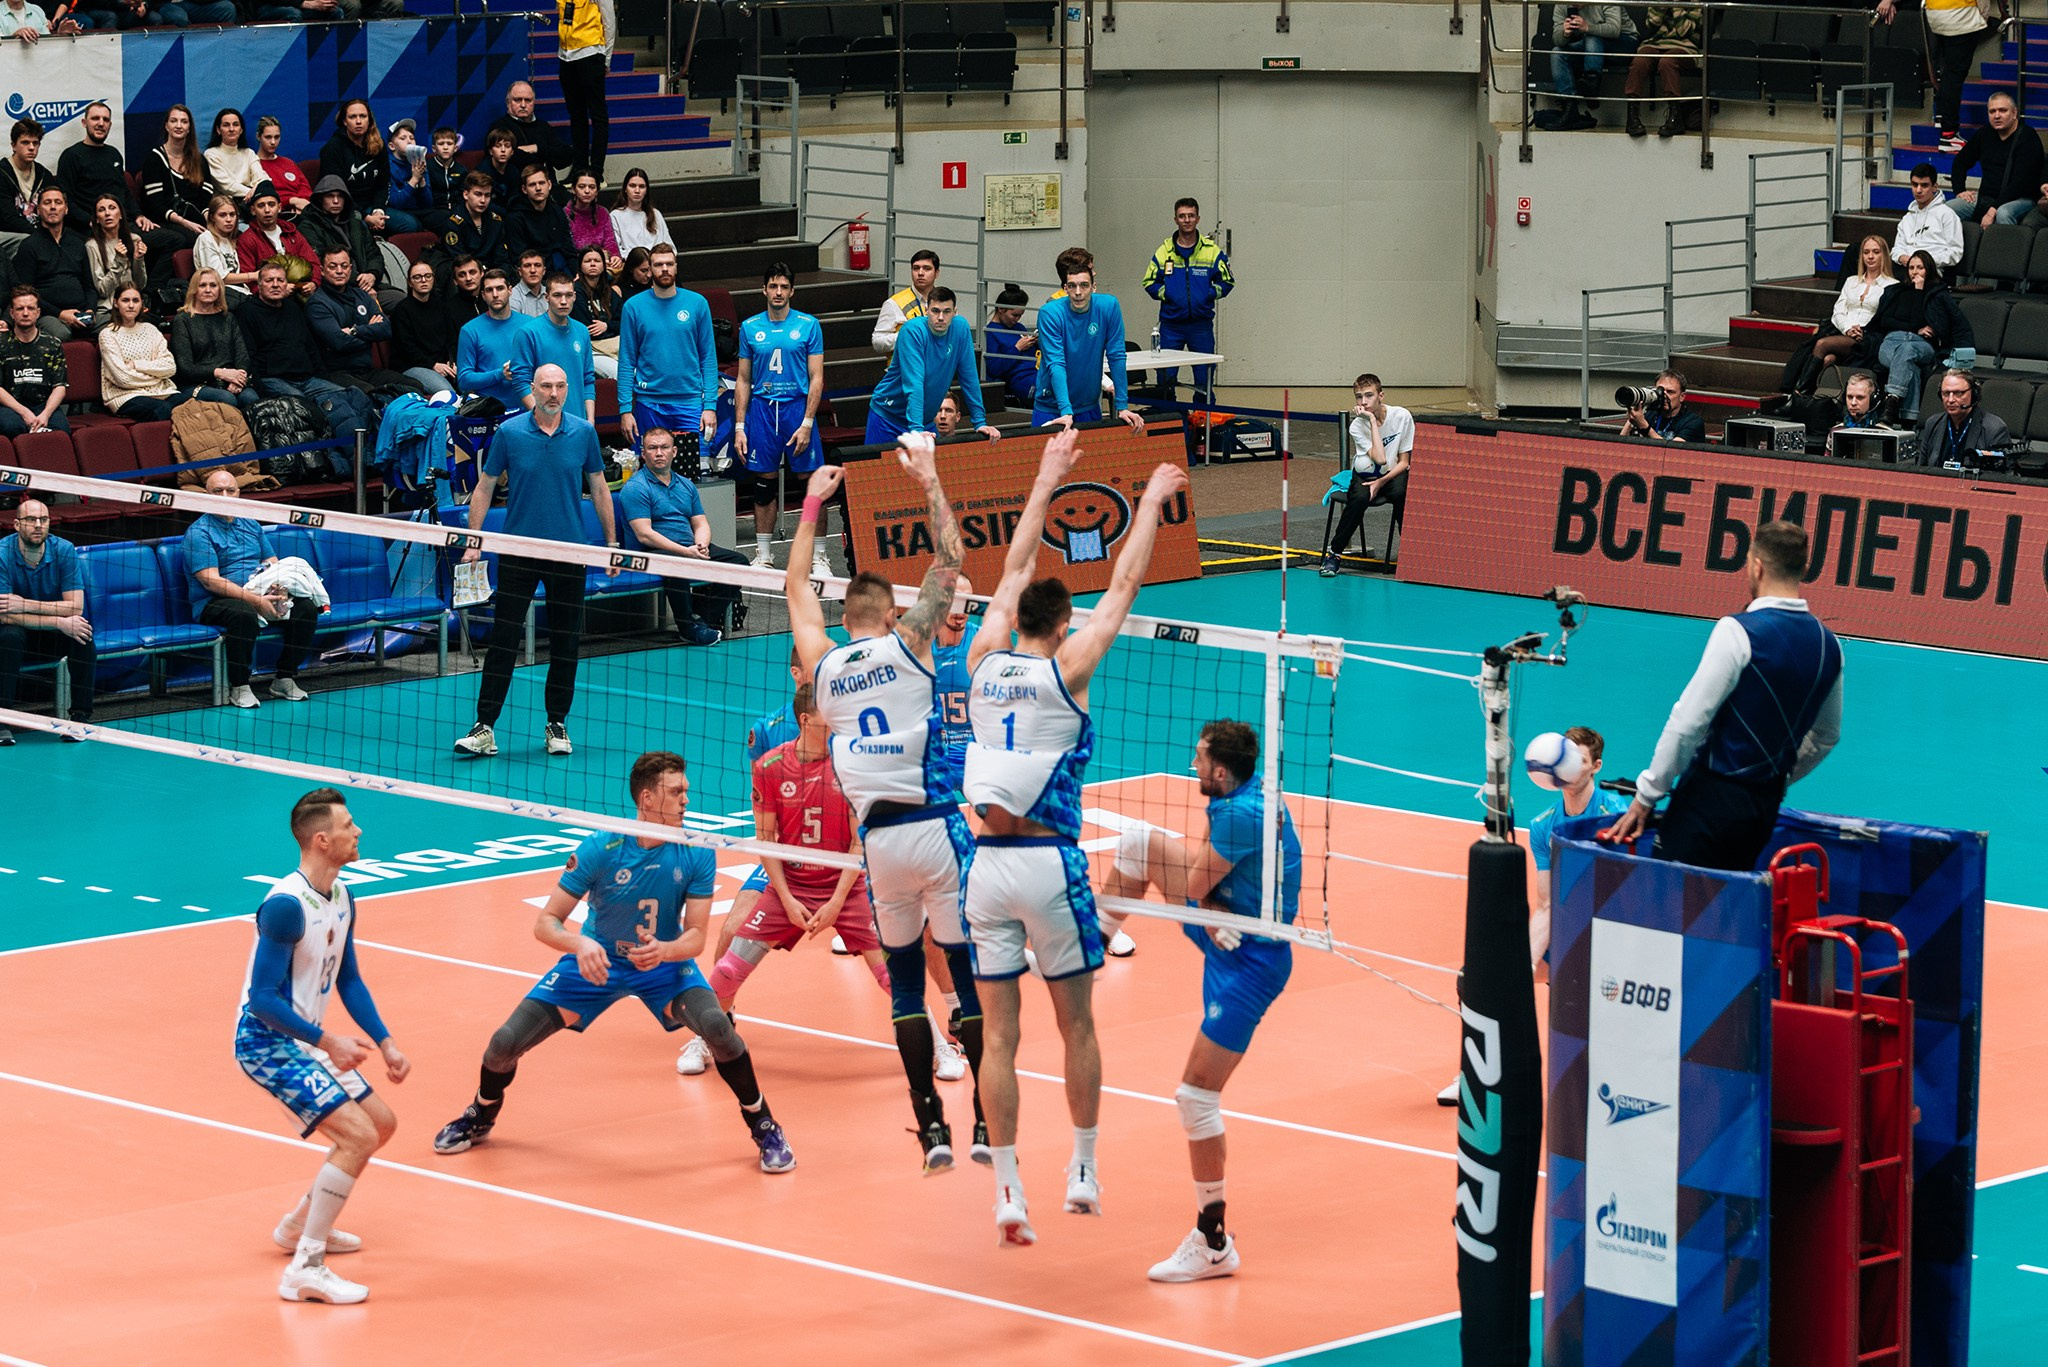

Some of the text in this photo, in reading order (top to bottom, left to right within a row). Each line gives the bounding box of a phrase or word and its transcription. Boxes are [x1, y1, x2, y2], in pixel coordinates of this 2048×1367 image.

[768, 348, 784, 375] 4
[1, 471, 29, 486] PARI
[142, 492, 173, 506] PARI
[292, 512, 323, 527] PARI
[1552, 466, 1694, 567] ВСЕ
[446, 533, 482, 549] PARI
[875, 510, 1023, 560] KASIR
[611, 554, 648, 570] PARI
[1157, 626, 1196, 642] PARI
[830, 664, 897, 697] ЯКОВЛЕВ
[939, 692, 968, 724] 15
[1001, 711, 1015, 751] 1
[801, 806, 822, 844] 5
[635, 898, 660, 936] 3
[751, 910, 766, 925] 5
[1621, 980, 1672, 1012] ВФВ
[303, 1069, 331, 1096] 23
[1456, 1001, 1502, 1263] PARI
[1617, 1222, 1667, 1249] ГАЗПРОМ
